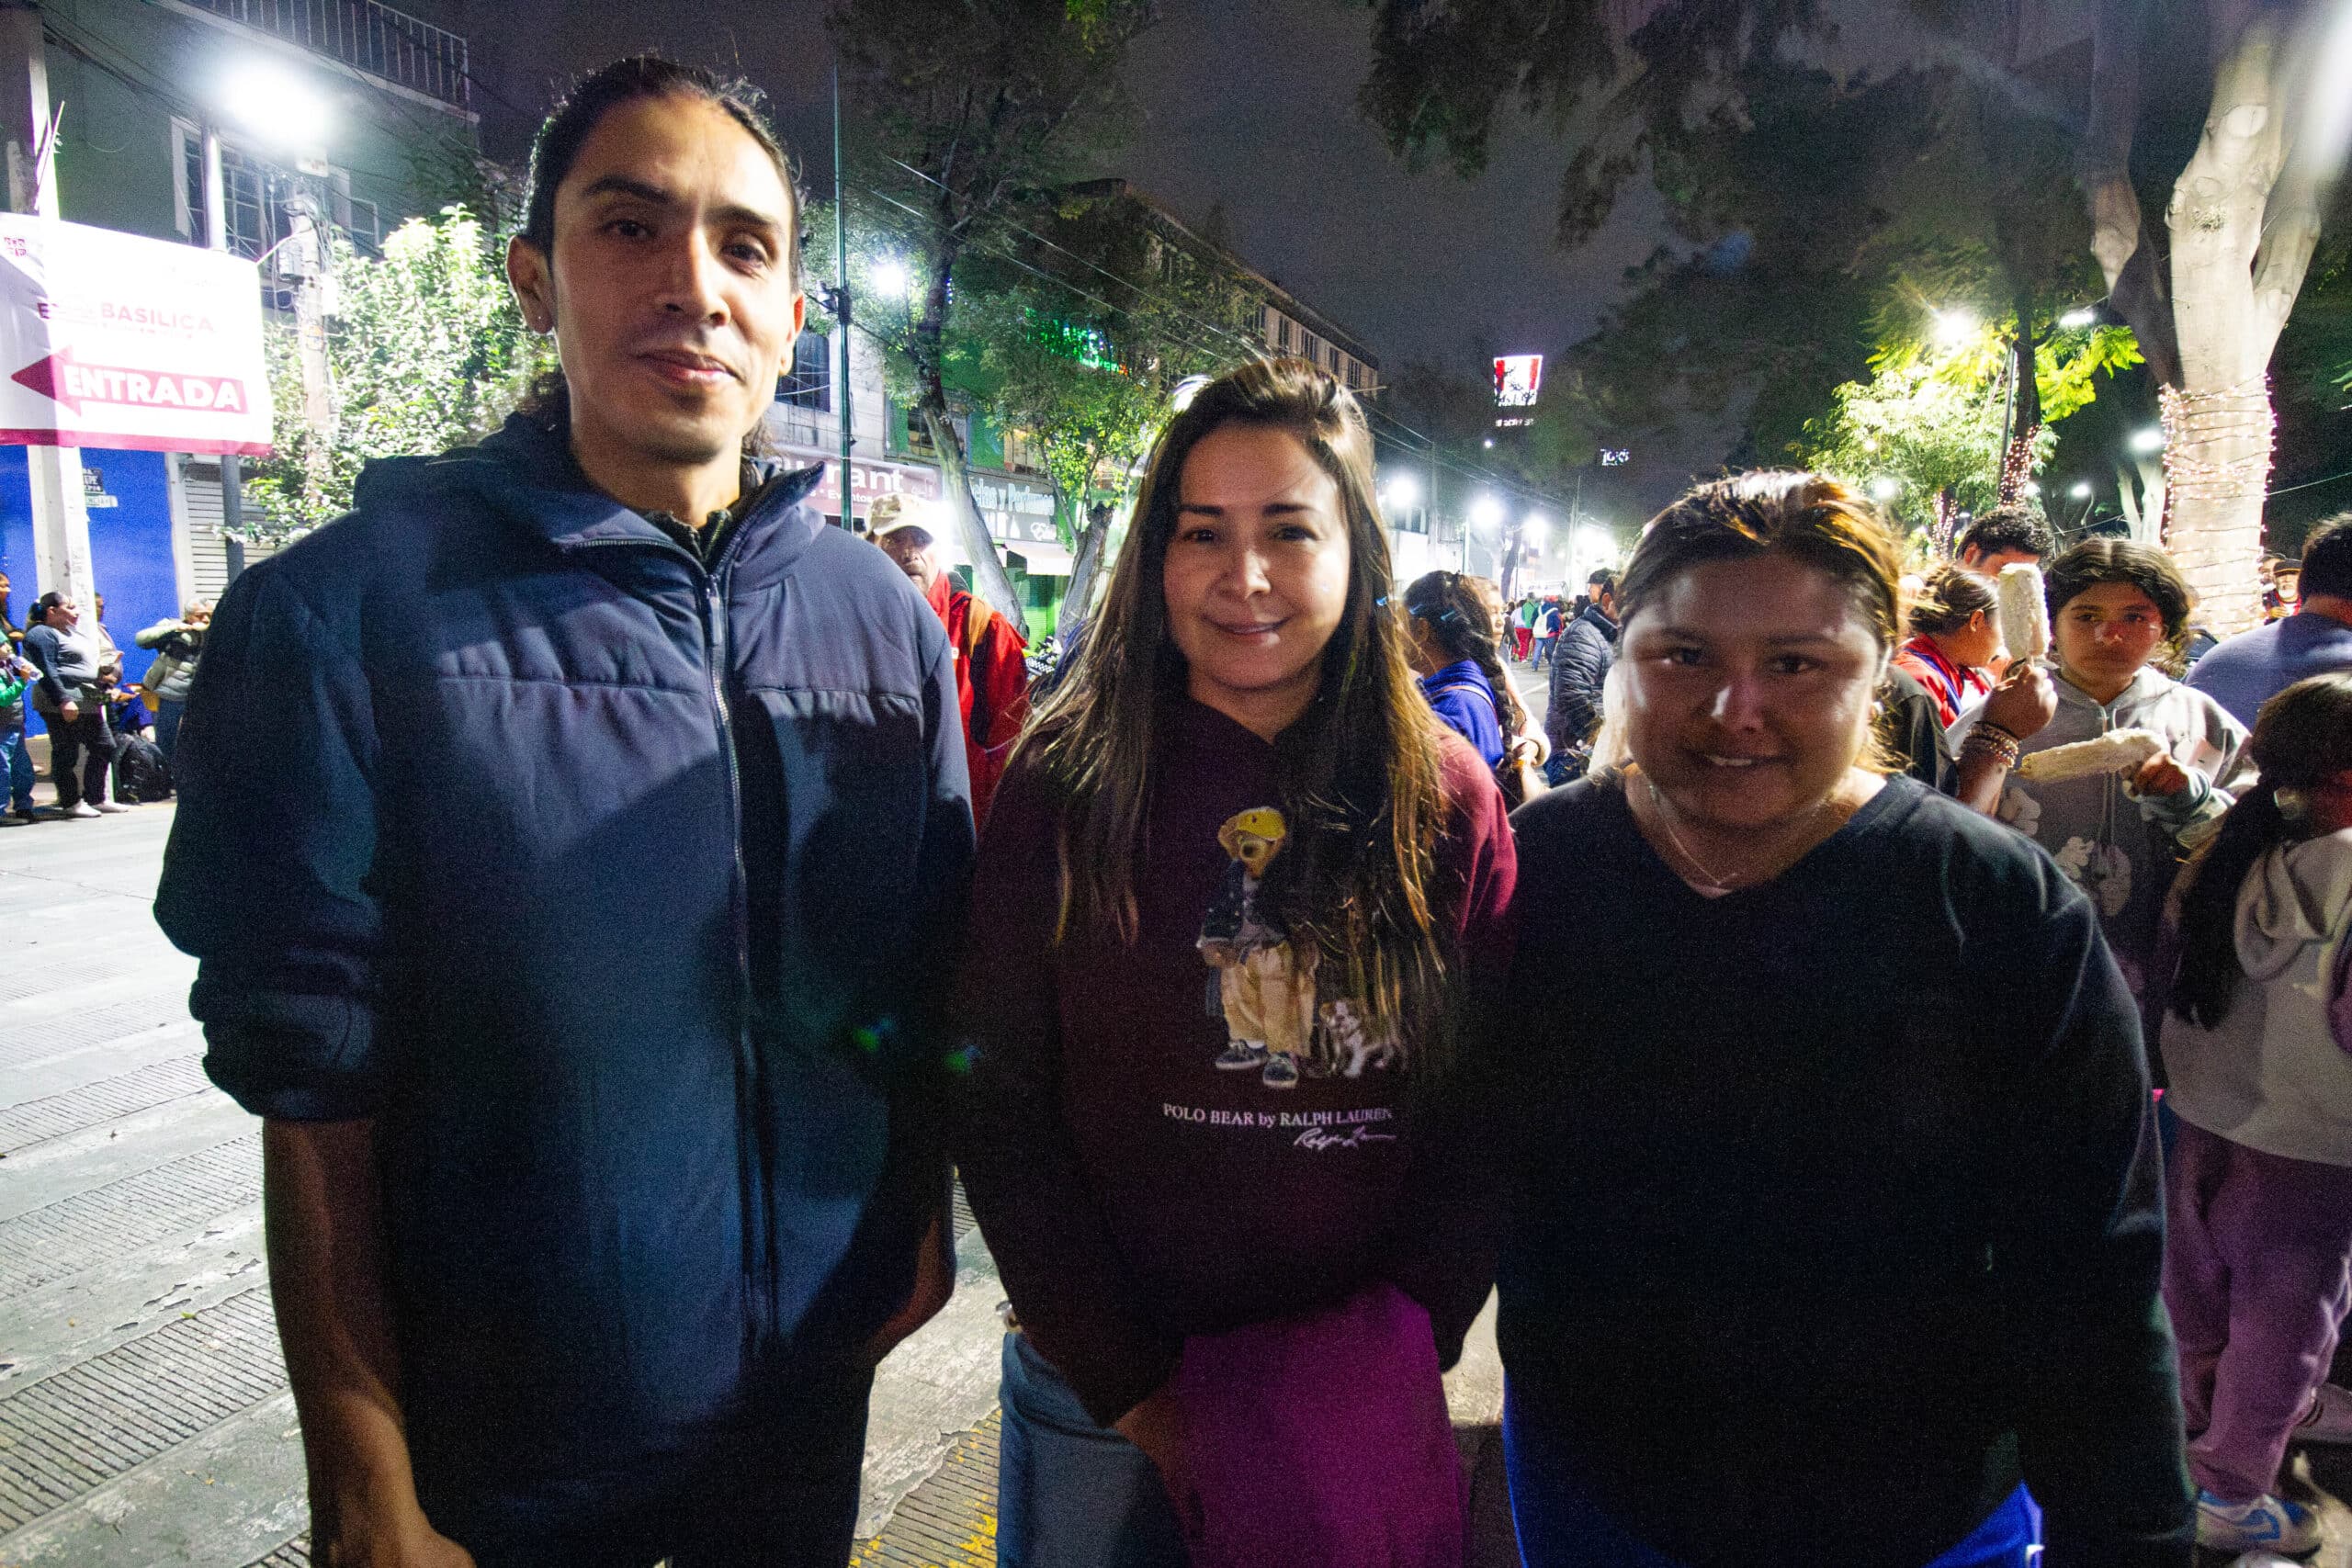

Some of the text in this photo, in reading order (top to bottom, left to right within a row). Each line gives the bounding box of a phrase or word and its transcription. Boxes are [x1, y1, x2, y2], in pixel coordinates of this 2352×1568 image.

[100, 301, 215, 333] BASILICA
[62, 365, 242, 410] ENTRADA
[828, 488, 873, 503] Evntos
[1162, 1102, 1394, 1129] POLO BEAR by RALPH LAUREN
